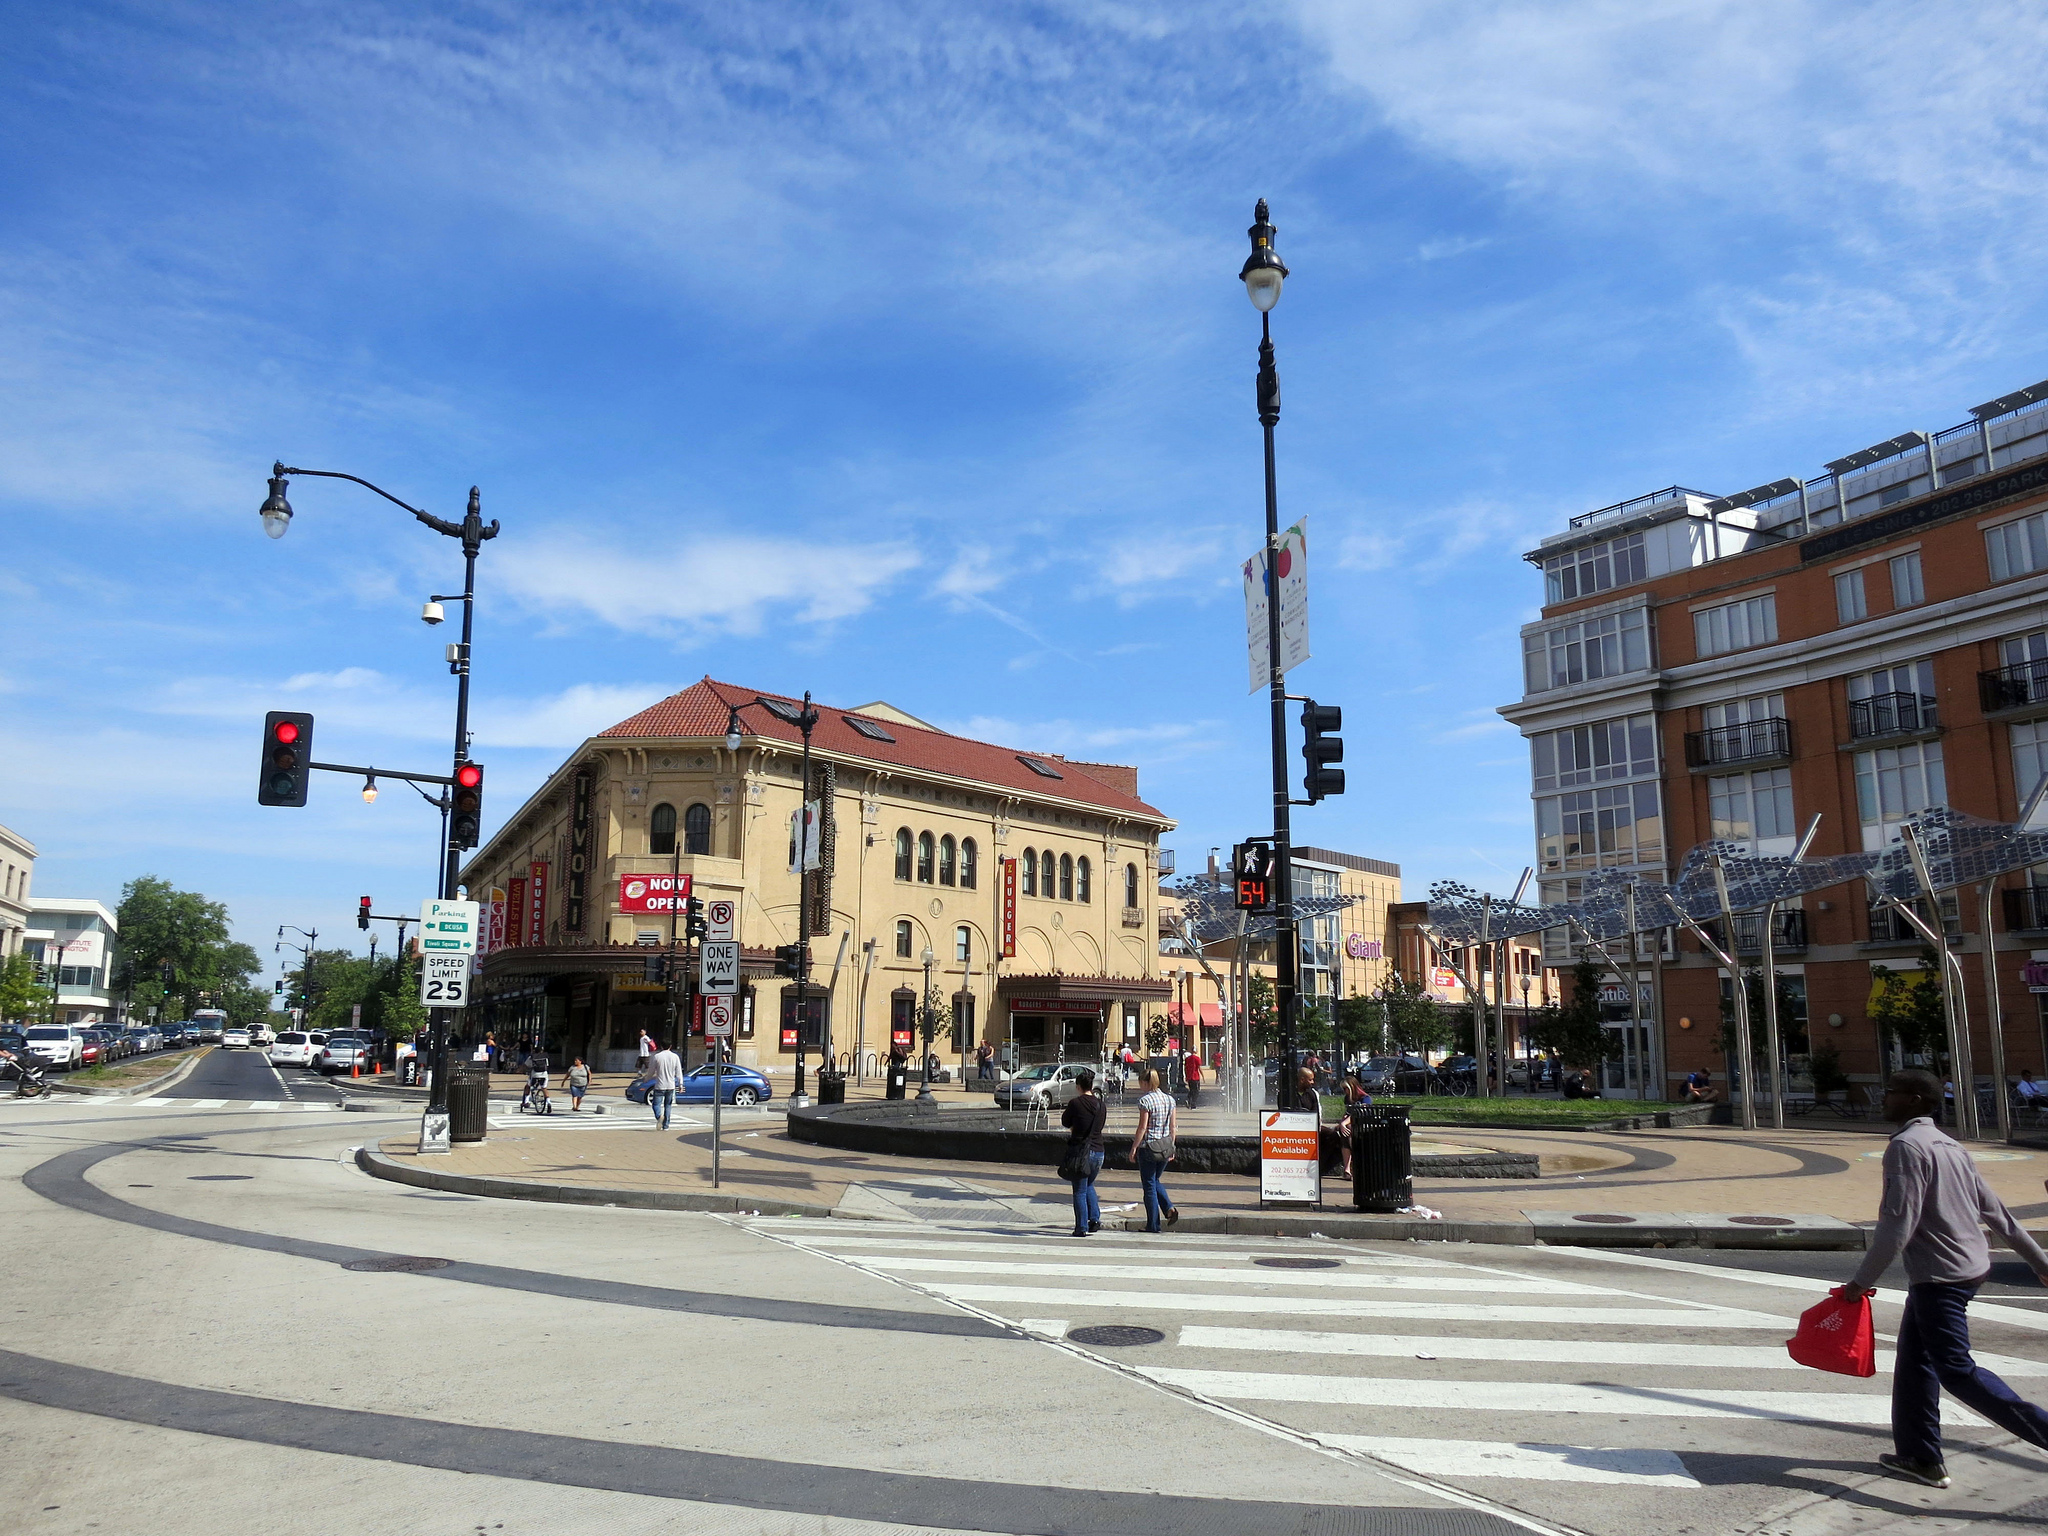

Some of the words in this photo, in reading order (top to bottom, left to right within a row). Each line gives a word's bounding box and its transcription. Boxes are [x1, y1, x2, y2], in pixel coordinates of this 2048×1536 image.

[570, 775, 589, 926] TIVOLI
[650, 878, 685, 891] NOW
[1240, 881, 1264, 905] 54
[511, 882, 521, 920] WELLS
[646, 897, 687, 910] OPEN
[432, 904, 466, 918] Parking
[532, 877, 542, 942] BURGER
[1005, 875, 1013, 943] BURGER
[444, 923, 464, 931] DCUSA
[489, 902, 505, 954] GALA
[707, 946, 733, 959] ONE
[1347, 933, 1382, 958] Giant
[429, 958, 464, 967] SPEED
[706, 961, 734, 974] WAY
[432, 970, 460, 979] LIMIT
[426, 980, 462, 1000] 25
[1596, 986, 1650, 1001] citibak
[406, 1061, 416, 1084] blade
[1264, 1136, 1316, 1145] Apartments
[1271, 1146, 1309, 1154] Available
[1264, 1189, 1291, 1197] Paradigm
